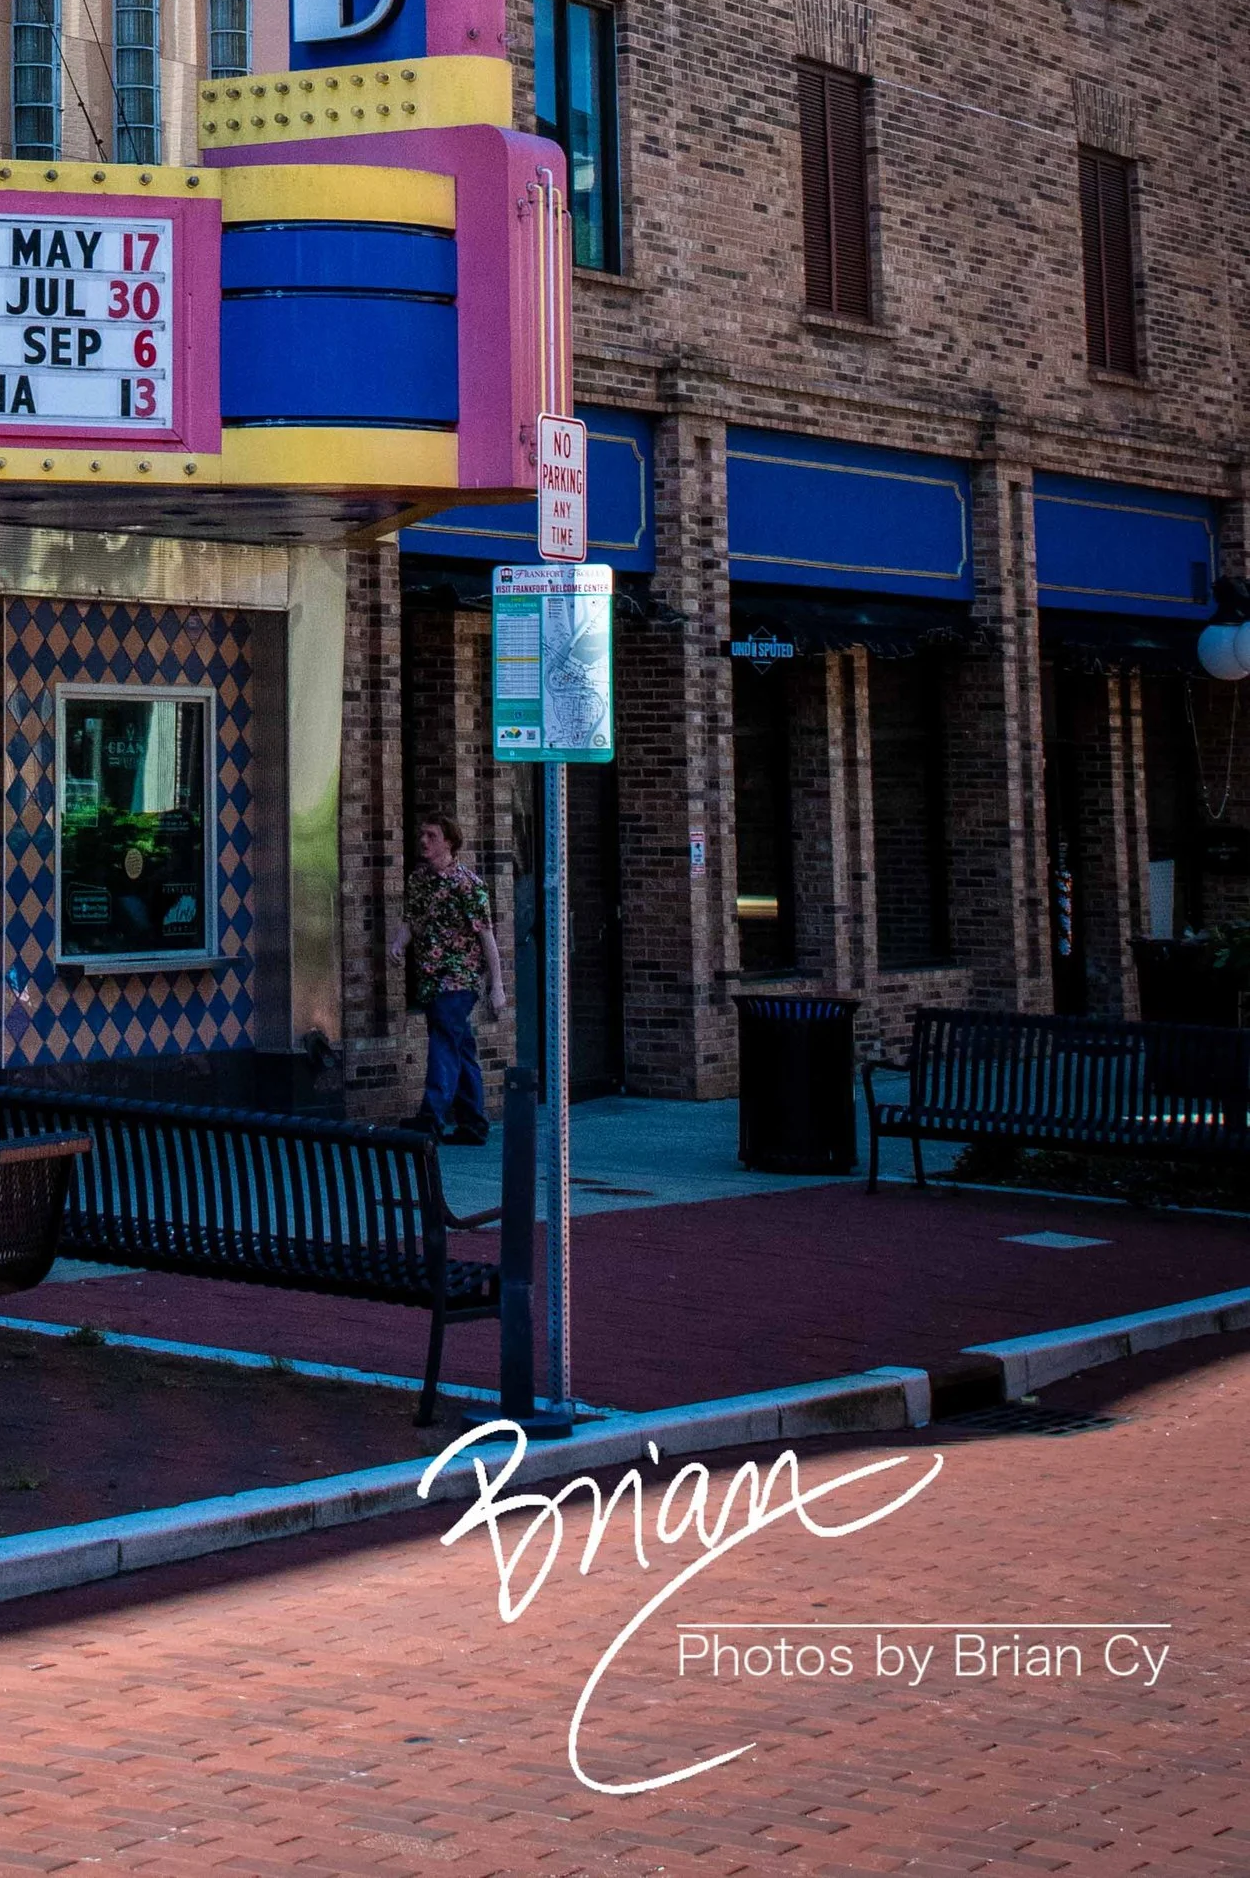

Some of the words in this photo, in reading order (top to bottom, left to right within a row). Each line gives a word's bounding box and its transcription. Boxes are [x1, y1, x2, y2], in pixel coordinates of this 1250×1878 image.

[10, 227, 102, 268] MAY
[122, 232, 160, 272] 17
[5, 276, 86, 316] JUL
[108, 280, 160, 322] 30
[23, 326, 102, 367] SEP
[133, 329, 157, 369] 6
[120, 377, 157, 418] 13
[553, 430, 571, 459] NO
[543, 463, 583, 495] PARKING
[553, 499, 572, 519] ANY
[551, 526, 574, 546] TIME
[495, 584, 511, 594] VISIT
[513, 584, 548, 594] FRANKFORT
[550, 583, 582, 594] WELCOME
[583, 583, 609, 593] CENTER
[514, 569, 566, 580] FRANKFORT
[731, 640, 795, 659] UNDISPUTED
